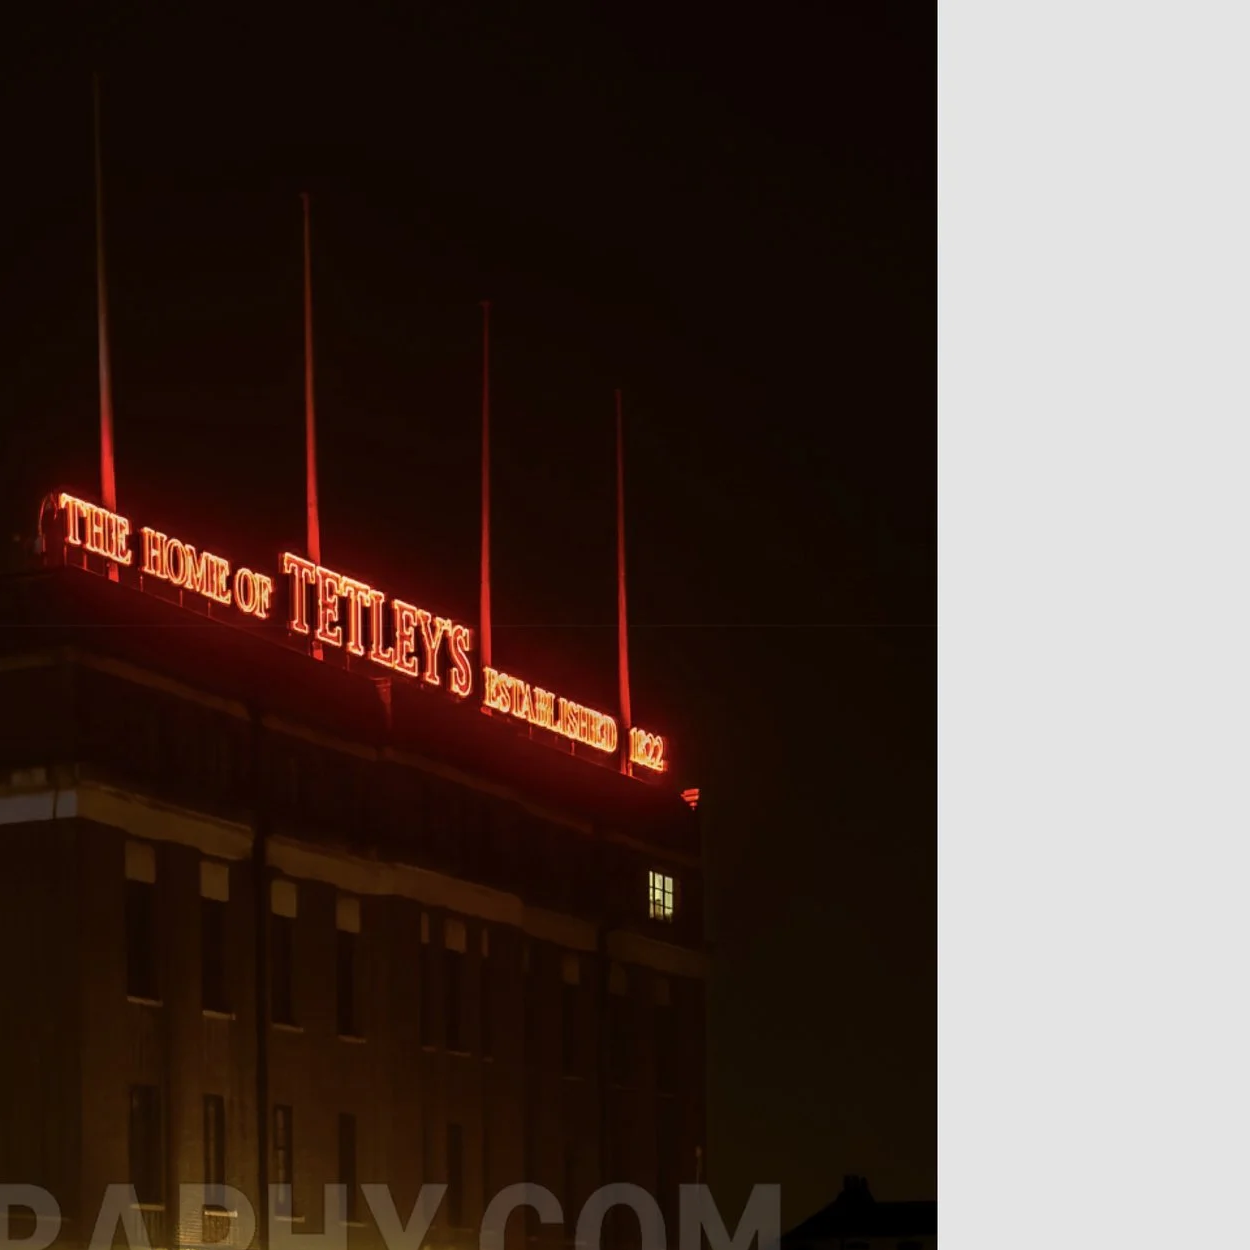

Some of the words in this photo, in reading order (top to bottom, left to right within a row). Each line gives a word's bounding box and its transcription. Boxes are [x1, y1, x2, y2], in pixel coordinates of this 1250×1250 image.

[59, 492, 131, 565] THE
[141, 526, 231, 604] HOME
[234, 567, 272, 618] OF
[282, 552, 472, 697] TETLEY'S
[483, 666, 618, 753] ESTABLISHED
[629, 727, 664, 772] 1822
